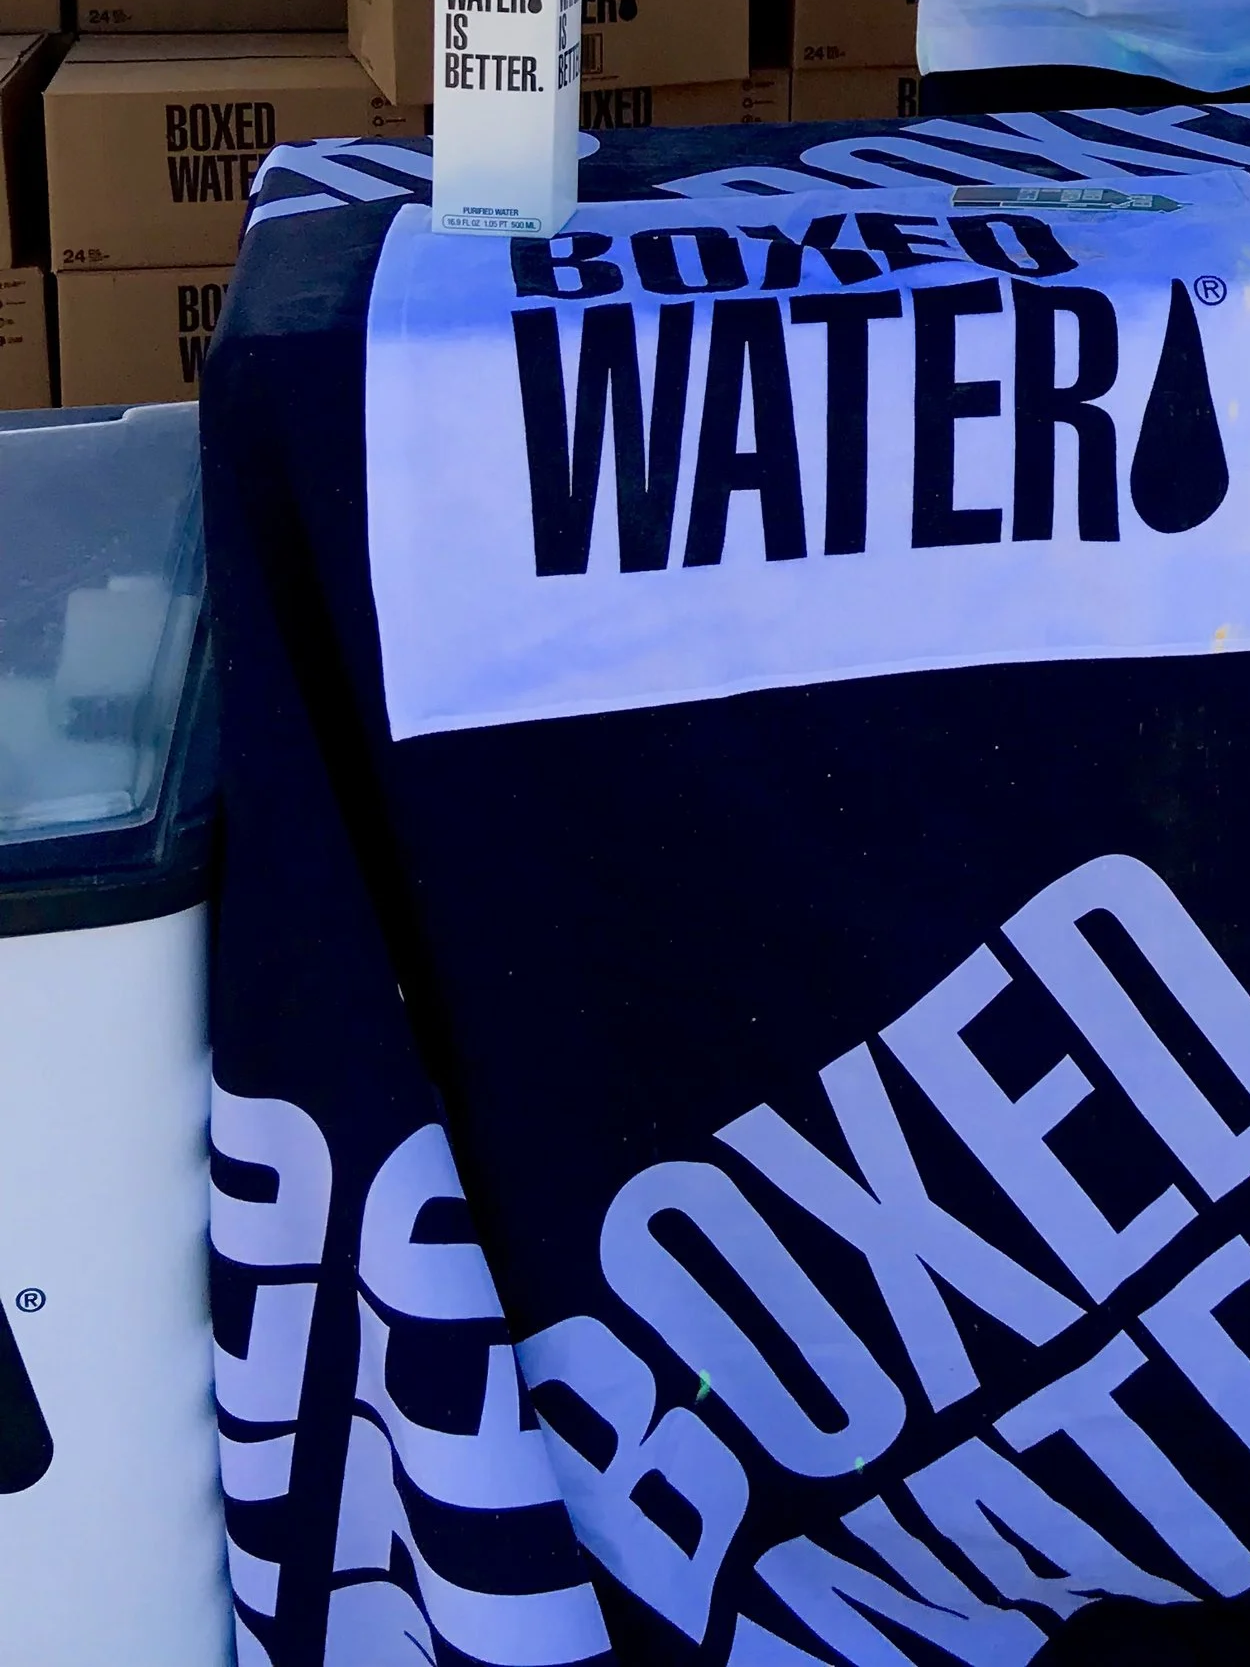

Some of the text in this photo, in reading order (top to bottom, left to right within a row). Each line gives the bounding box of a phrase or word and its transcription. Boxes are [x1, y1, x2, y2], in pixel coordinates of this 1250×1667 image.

[445, 13, 469, 51] IS
[558, 12, 567, 52] IS
[444, 52, 544, 93] BETTER.
[165, 101, 277, 153] BOXED
[167, 153, 264, 203] WATE
[463, 207, 519, 216] PURIFIED WATER
[510, 212, 1079, 299] BOXED
[510, 276, 1121, 577] WATER
